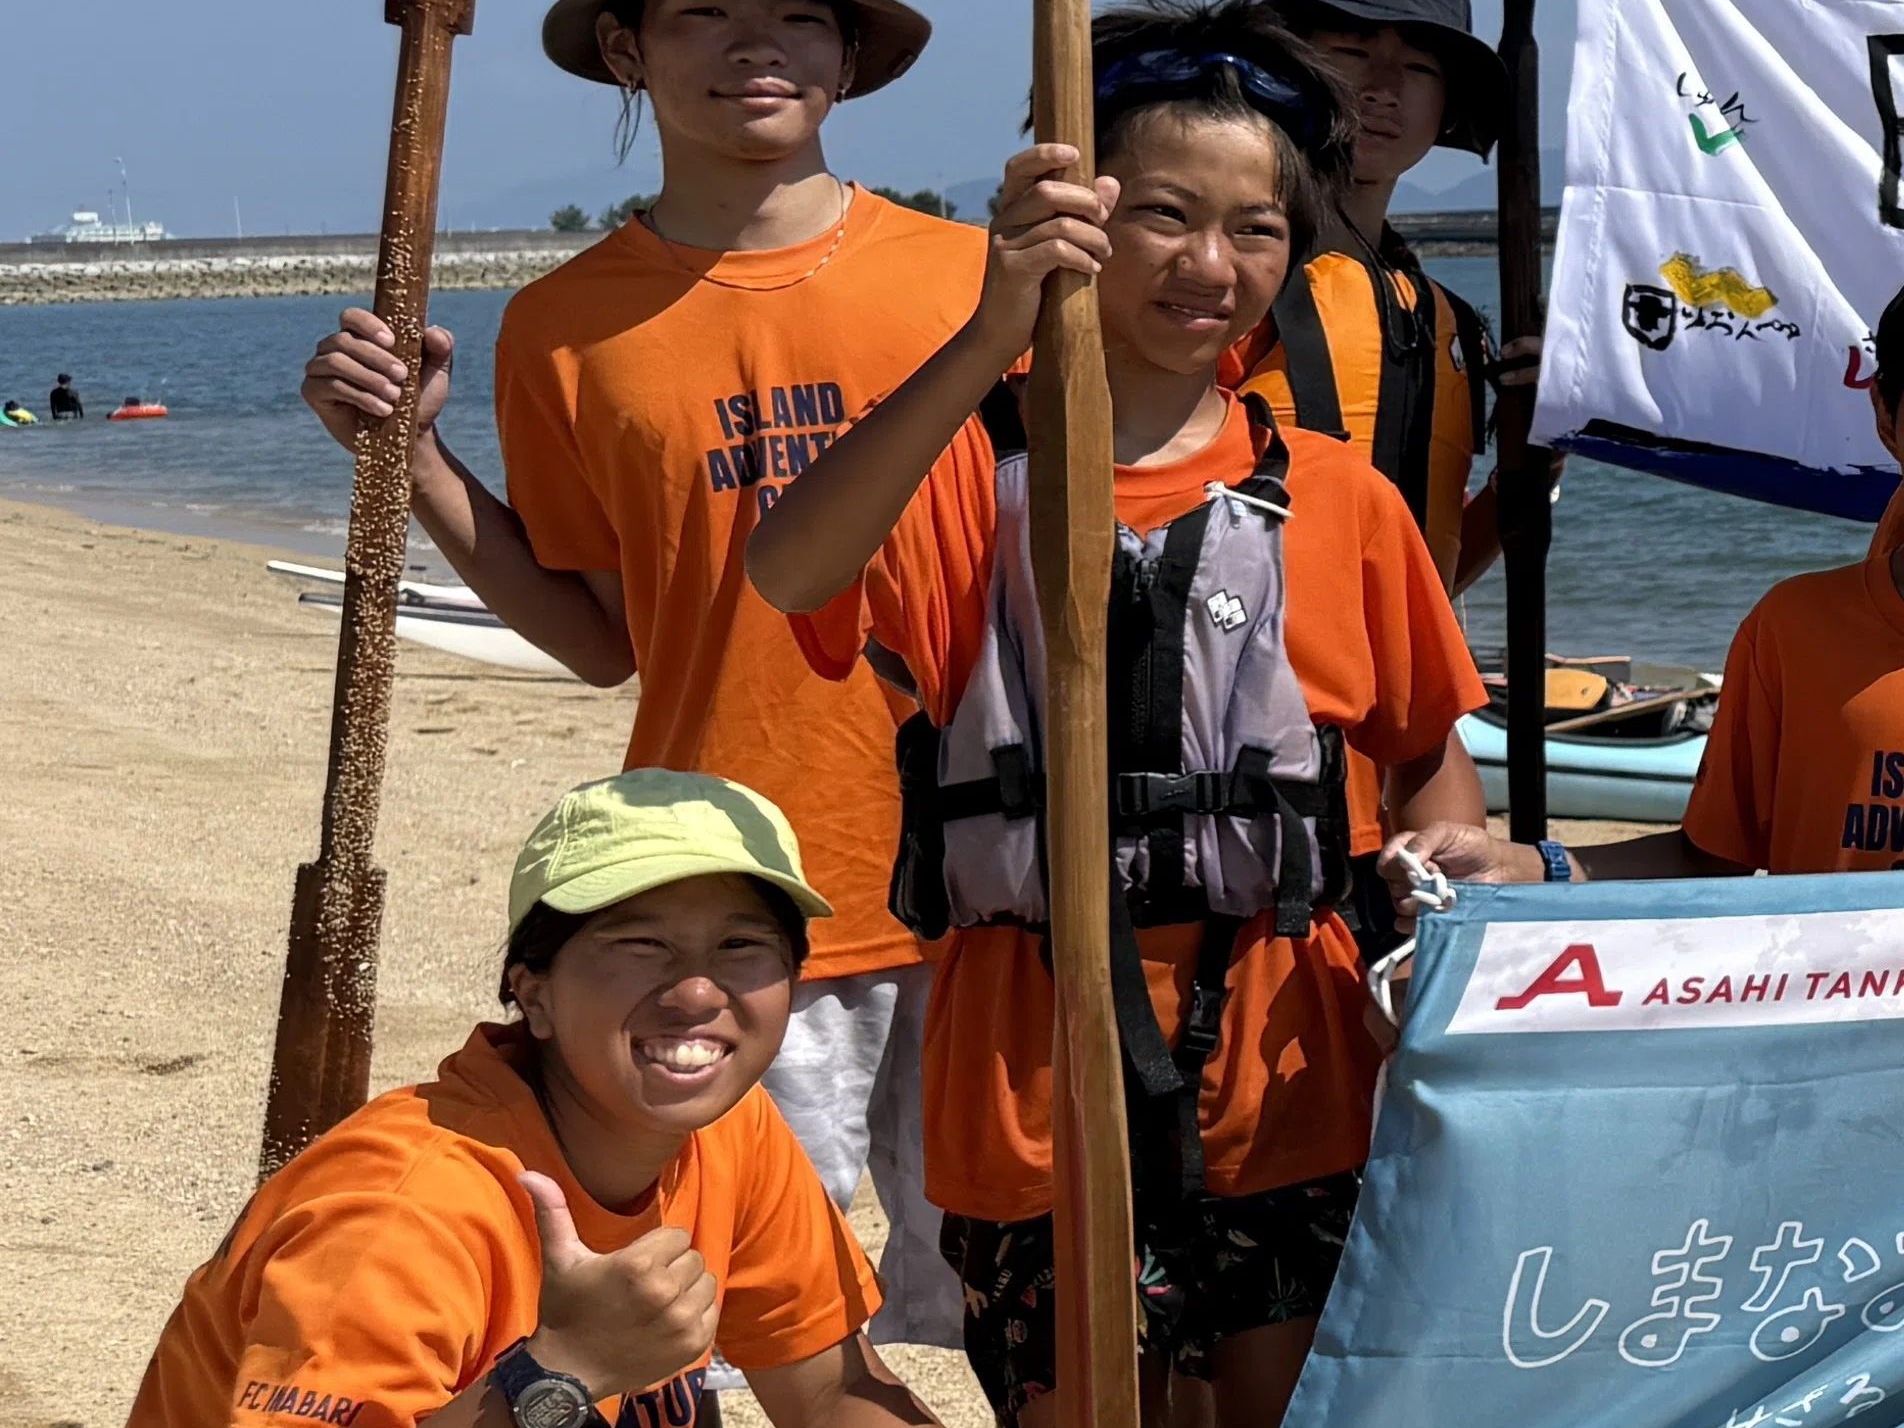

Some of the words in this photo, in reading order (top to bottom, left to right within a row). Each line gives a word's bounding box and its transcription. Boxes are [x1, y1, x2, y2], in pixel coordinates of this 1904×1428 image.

[714, 382, 844, 440] ISLAND
[706, 431, 836, 492] ADVENT
[1641, 973, 1784, 1005] ASAHI
[237, 1380, 270, 1411] FC
